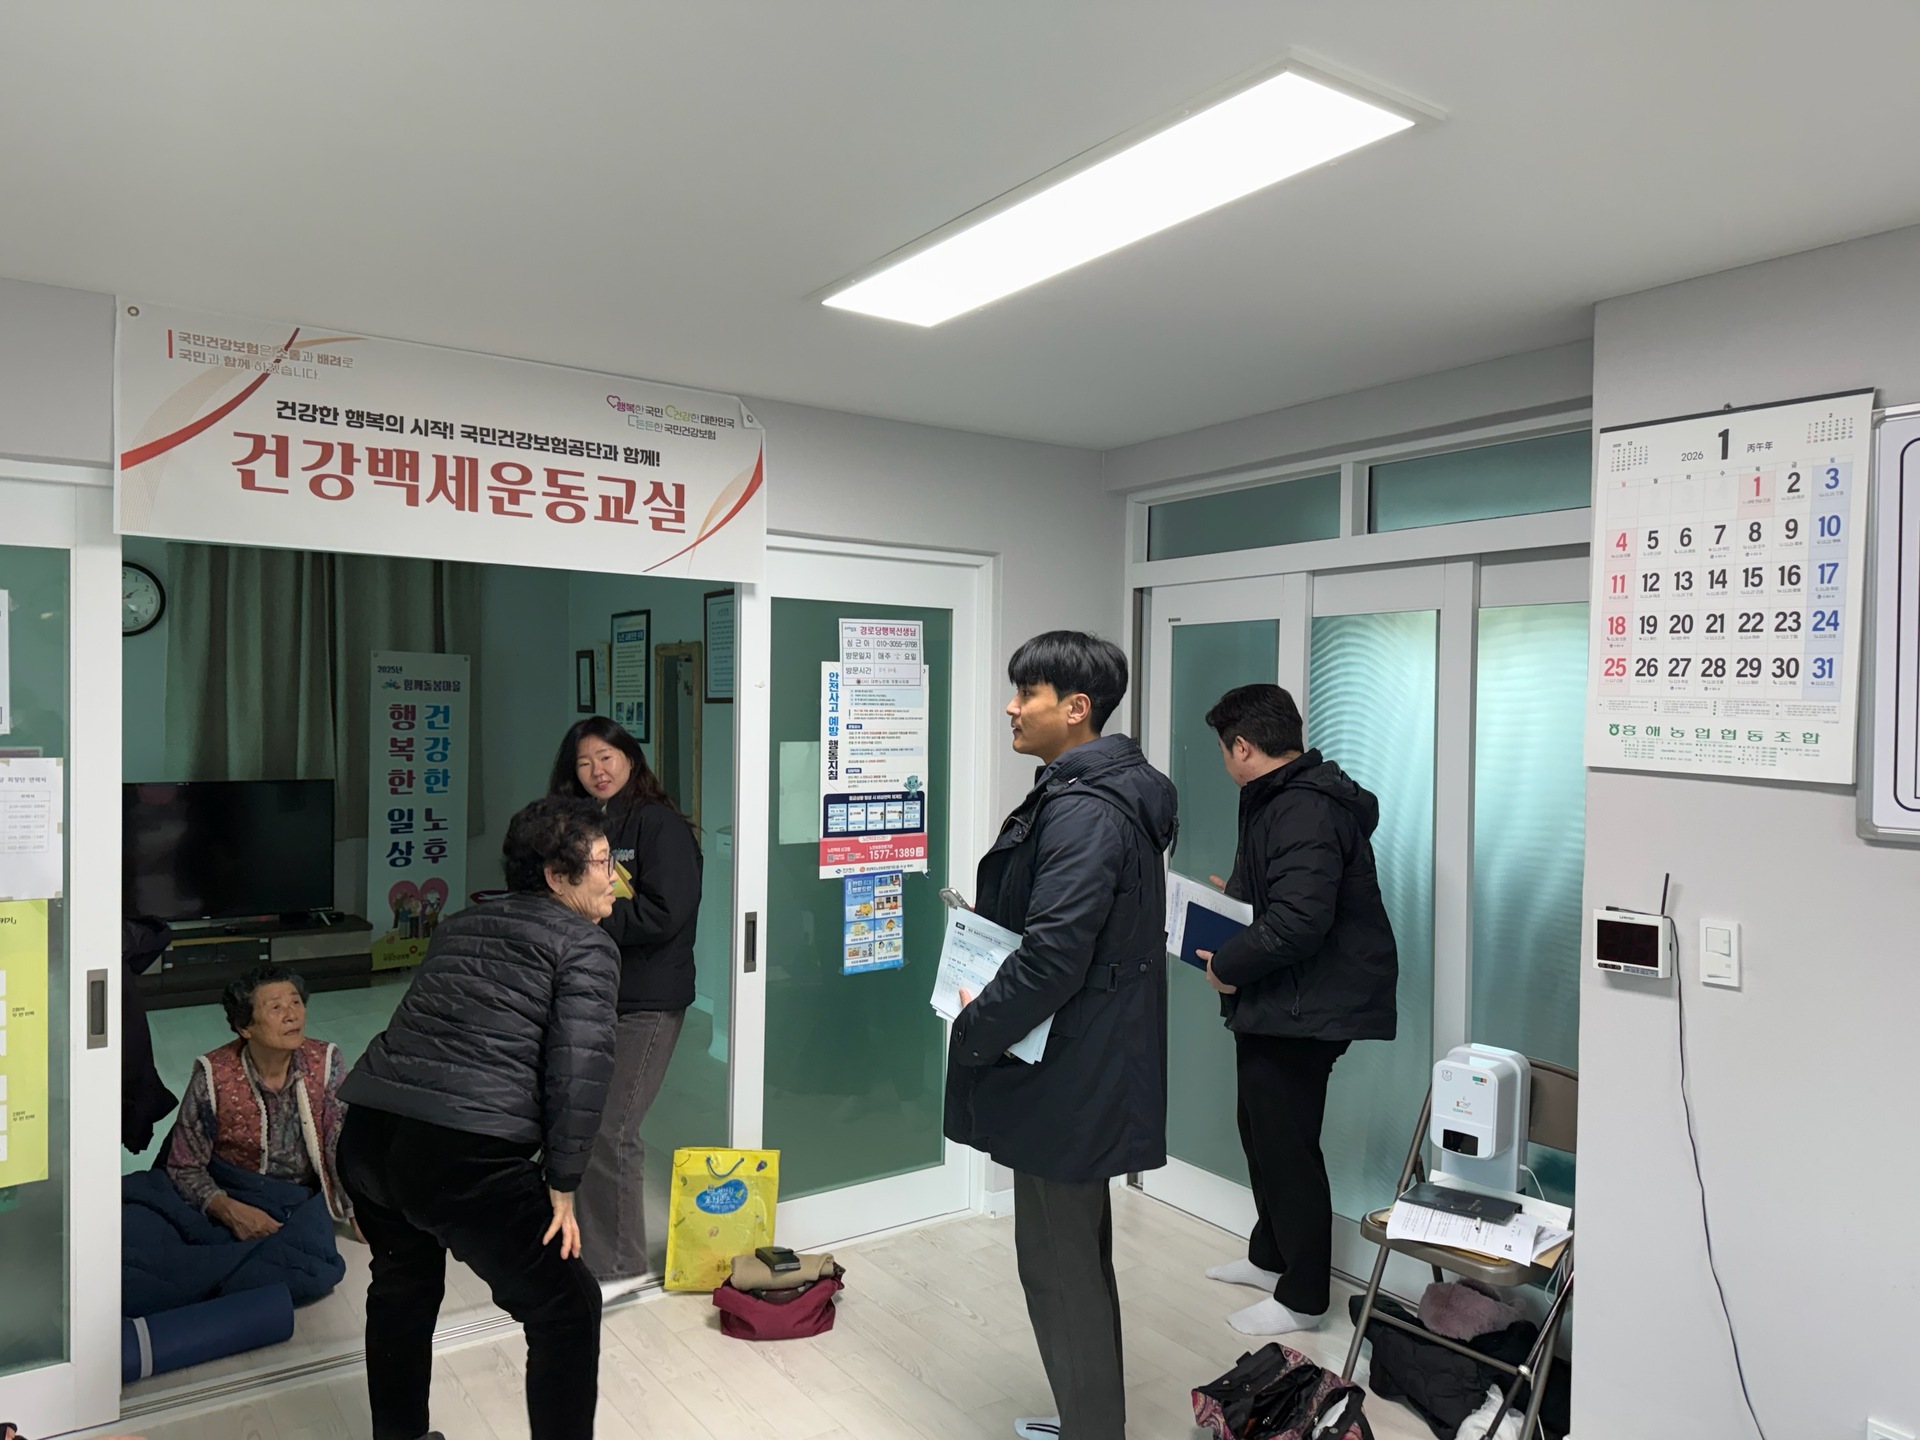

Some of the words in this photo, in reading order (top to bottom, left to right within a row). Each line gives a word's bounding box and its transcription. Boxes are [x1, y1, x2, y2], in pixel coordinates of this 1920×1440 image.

[178, 331, 272, 357] 국민건강보험은
[317, 352, 354, 369] 배려로
[178, 348, 219, 365] 국민과
[223, 355, 251, 370] 함께
[254, 360, 321, 380] 하겠습니다.
[616, 401, 645, 415] 행복한
[645, 405, 663, 418] 국민
[700, 414, 735, 428] 대한민국
[276, 400, 339, 426] 건강한
[345, 409, 404, 433] 행복의
[410, 418, 454, 440] 시작!
[460, 424, 618, 461] 국민건강보험공단과
[623, 446, 660, 467] 함께!
[664, 423, 716, 440] 국민건강보험
[1680, 450, 1705, 462] 2026
[1717, 428, 1730, 461] 1
[231, 431, 686, 534] 건강백세운동교실
[1753, 476, 1761, 497] 1
[1786, 471, 1801, 494] 2
[1824, 467, 1840, 490] 3
[1615, 532, 1628, 552] 4
[1647, 529, 1659, 550] 5
[1679, 527, 1692, 548] 6
[1714, 524, 1727, 545] 7
[1748, 521, 1762, 543] 8
[1784, 518, 1799, 540] 9
[1818, 514, 1841, 538] 10
[1611, 574, 1626, 594] 11
[1641, 572, 1660, 593] 12
[1674, 570, 1694, 591] 13
[1708, 568, 1728, 590] 14
[1742, 566, 1764, 588] 15
[1778, 564, 1801, 587] 16
[1817, 562, 1840, 585] 17
[860, 626, 916, 637] 경로당행복선생님
[1608, 615, 1626, 636] 18
[1639, 614, 1658, 635] 19
[1668, 613, 1694, 634] 20
[1705, 613, 1725, 634] 21
[1737, 611, 1765, 633] 22
[1773, 610, 1802, 633] 23
[1811, 609, 1840, 632] 24
[846, 651, 871, 660] 방문일자
[878, 652, 891, 660] 매주
[846, 666, 872, 675] 방문시간
[1603, 657, 1627, 677] 25
[1634, 657, 1659, 678] 26
[1667, 657, 1692, 678] 27
[1700, 657, 1727, 678] 28
[1735, 657, 1762, 679] 29
[1771, 657, 1800, 679] 30
[1812, 657, 1834, 679] 31
[828, 672, 839, 713] 안전사고
[828, 716, 839, 737] 예방
[388, 703, 417, 796] 행복한
[423, 703, 451, 795] 건강한
[828, 740, 839, 781] 행동지침
[385, 807, 415, 868] 일상
[422, 807, 449, 865] 노후
[869, 847, 915, 860] 1577-1389
